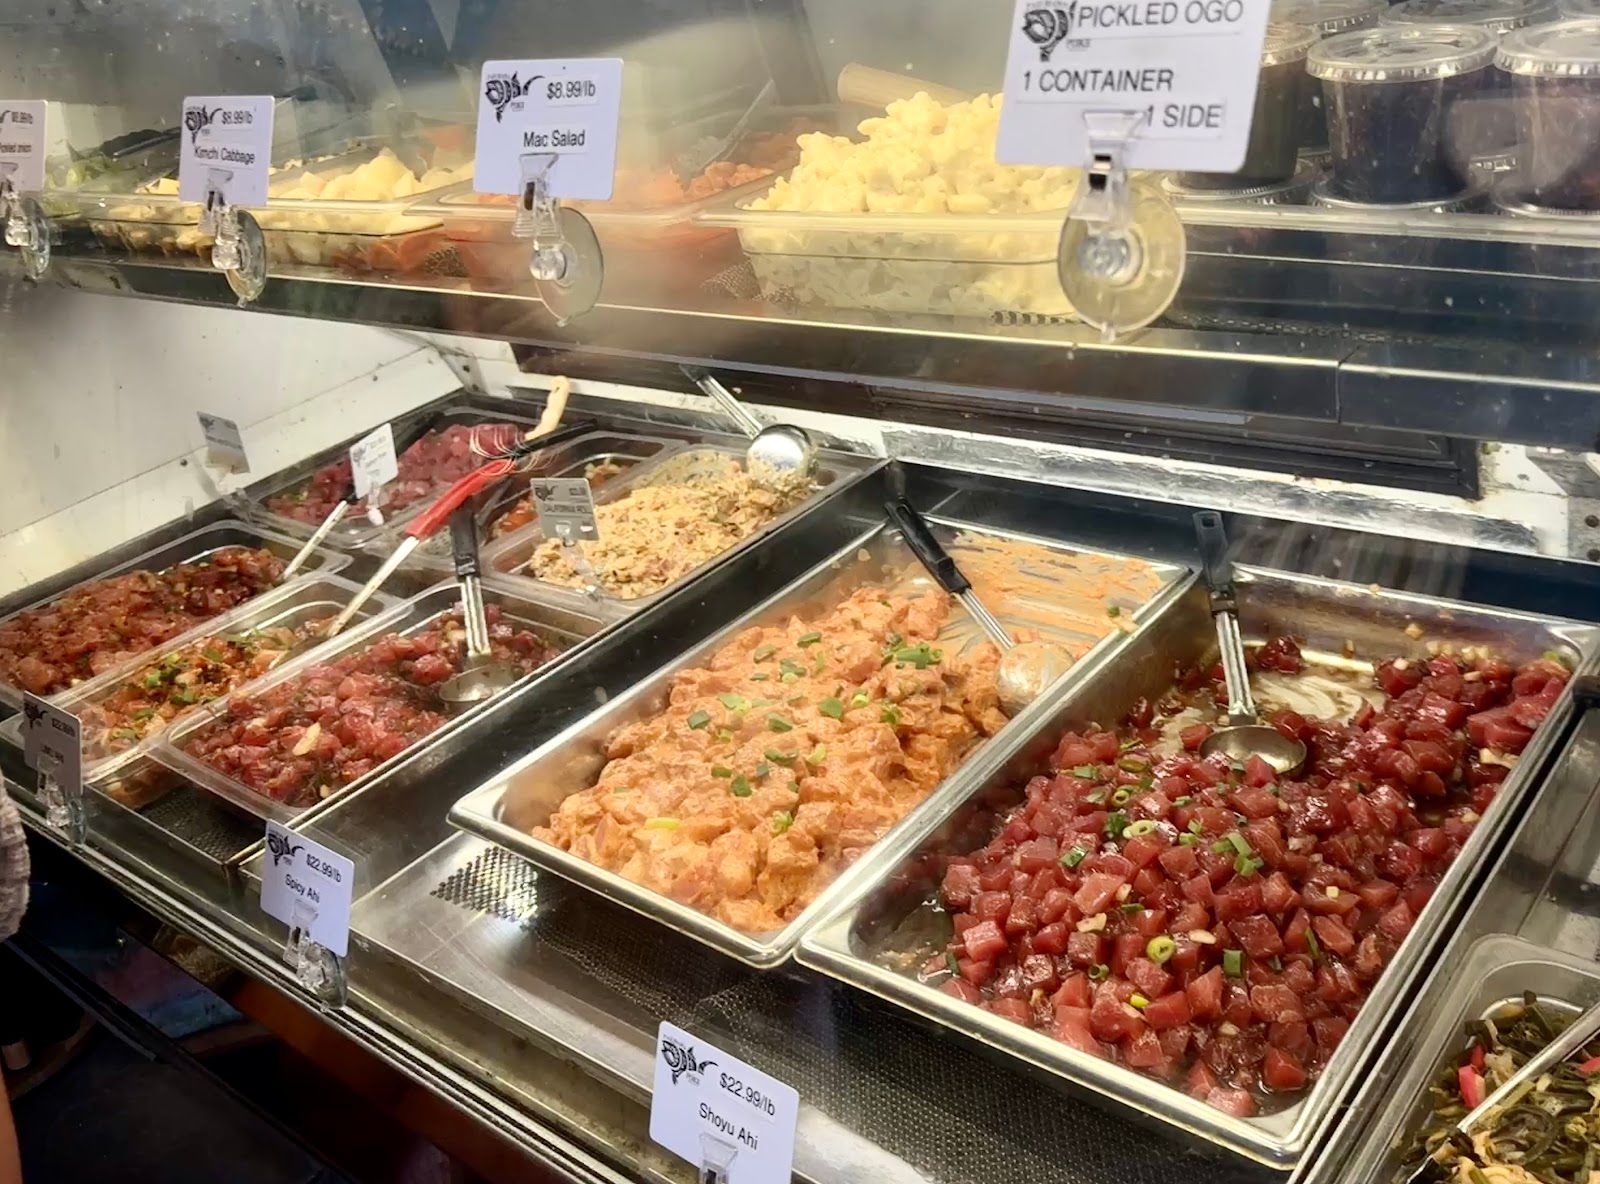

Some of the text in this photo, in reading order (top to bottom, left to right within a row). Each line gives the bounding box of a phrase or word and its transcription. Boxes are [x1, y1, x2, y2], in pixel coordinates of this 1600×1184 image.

[1078, 0, 1244, 28] PICKLED OGO
[547, 80, 596, 100] $8.99/lb
[1023, 69, 1175, 93] 1 CONTAINER
[1147, 104, 1223, 128] 1 SIDE
[523, 129, 586, 148] Mac Salad
[221, 147, 255, 166] Cabbage
[306, 853, 342, 883] $22.99/lb
[285, 873, 320, 903] Spicy Ahi
[719, 1072, 776, 1116] $22.99/lb
[699, 1102, 758, 1151] Shoyu Ahi
